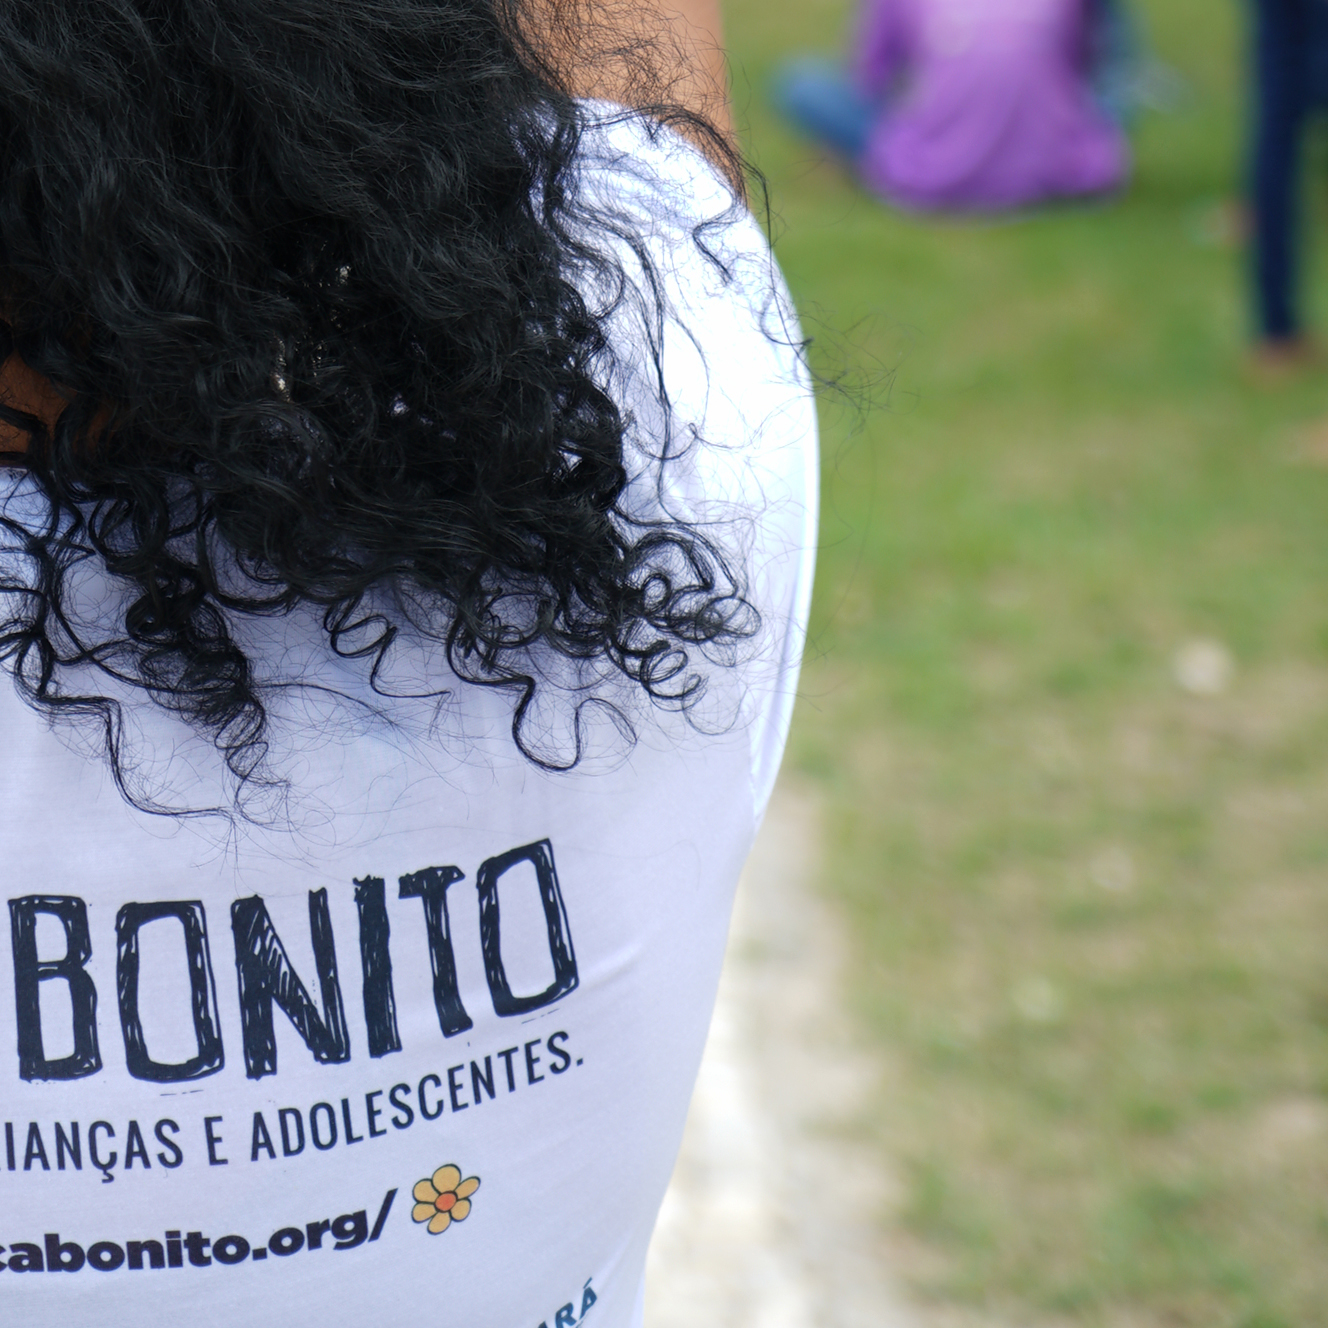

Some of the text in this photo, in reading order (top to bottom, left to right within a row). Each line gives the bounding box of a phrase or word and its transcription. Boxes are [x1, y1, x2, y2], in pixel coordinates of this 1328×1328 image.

[7, 836, 581, 1085] BONITO
[204, 1115, 229, 1167] E
[250, 1031, 586, 1162] ADOLESCENTES.
